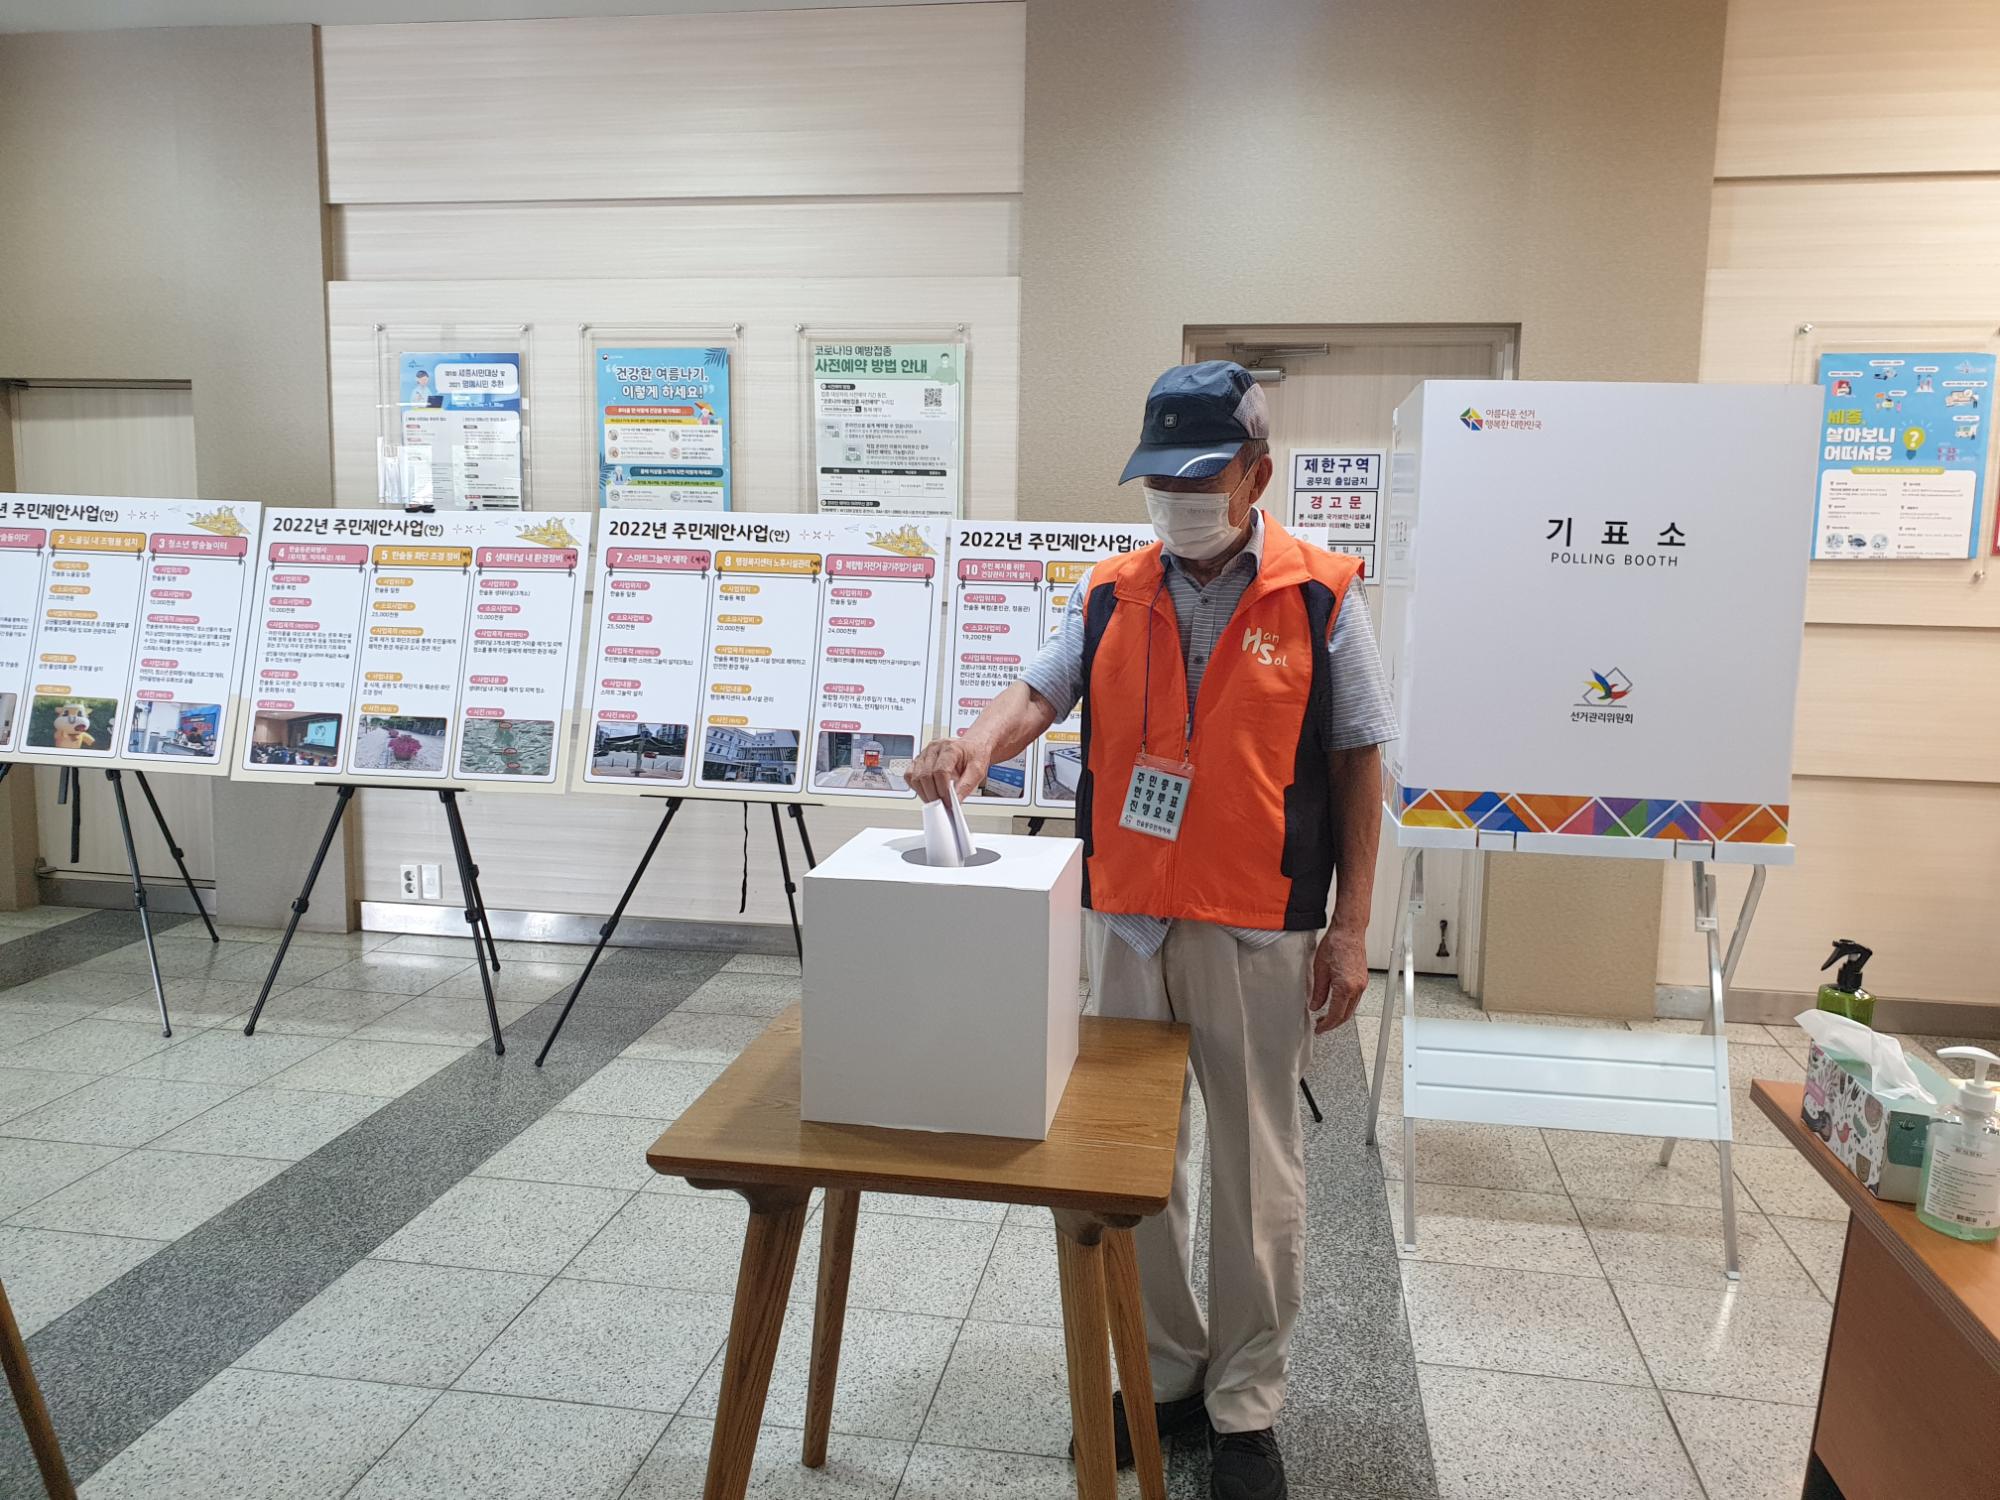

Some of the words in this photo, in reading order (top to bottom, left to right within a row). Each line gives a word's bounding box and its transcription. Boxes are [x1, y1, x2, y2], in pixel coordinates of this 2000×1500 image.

[815, 345, 852, 356] 코로나19
[854, 345, 892, 357] 예방접종
[815, 358, 868, 373] 사전예약
[871, 359, 897, 373] 방법
[900, 359, 928, 374] 안내
[616, 367, 652, 381] 건강한
[491, 380, 504, 388] 추천
[622, 384, 658, 400] 이렇게
[662, 384, 704, 400] 하세요!
[1485, 408, 1517, 419] 아름다운
[1519, 408, 1536, 419] 선거
[1485, 419, 1510, 430] 행복한
[1511, 420, 1543, 430] 대한민국
[1826, 427, 1896, 443] 살아보니
[1304, 457, 1369, 474] 제한구역
[1306, 476, 1331, 486] 공무외
[1335, 476, 1368, 486] 출입금지
[12, 502, 119, 523] 주민제안사업(안)
[272, 517, 328, 535] 2022년
[333, 518, 444, 537] 주민제안사업(안)
[608, 521, 667, 539] 2022년
[672, 522, 790, 543] 주민제안사업(안)
[1546, 517, 1686, 547] 기표소
[58, 534, 65, 544] 2
[159, 538, 166, 548] 3
[959, 530, 1022, 550] 2022년
[278, 547, 285, 558] 4
[381, 549, 388, 560] 5
[485, 551, 492, 562] 6
[616, 552, 623, 563] 7
[724, 555, 732, 567] 8
[835, 559, 843, 571] 9
[1551, 552, 1615, 565] POLLING
[1624, 554, 1678, 567] BOOTH
[966, 564, 978, 575] 10
[1055, 566, 1066, 577] 11
[963, 603, 979, 611] 한솔동
[971, 624, 1002, 633] 소요사업비
[1241, 627, 1279, 655] Han
[968, 654, 992, 663] 사업목적
[1257, 643, 1289, 667] Sol
[1570, 711, 1634, 724] 선거관리위원회
[1129, 800, 1176, 823] 진행요원
